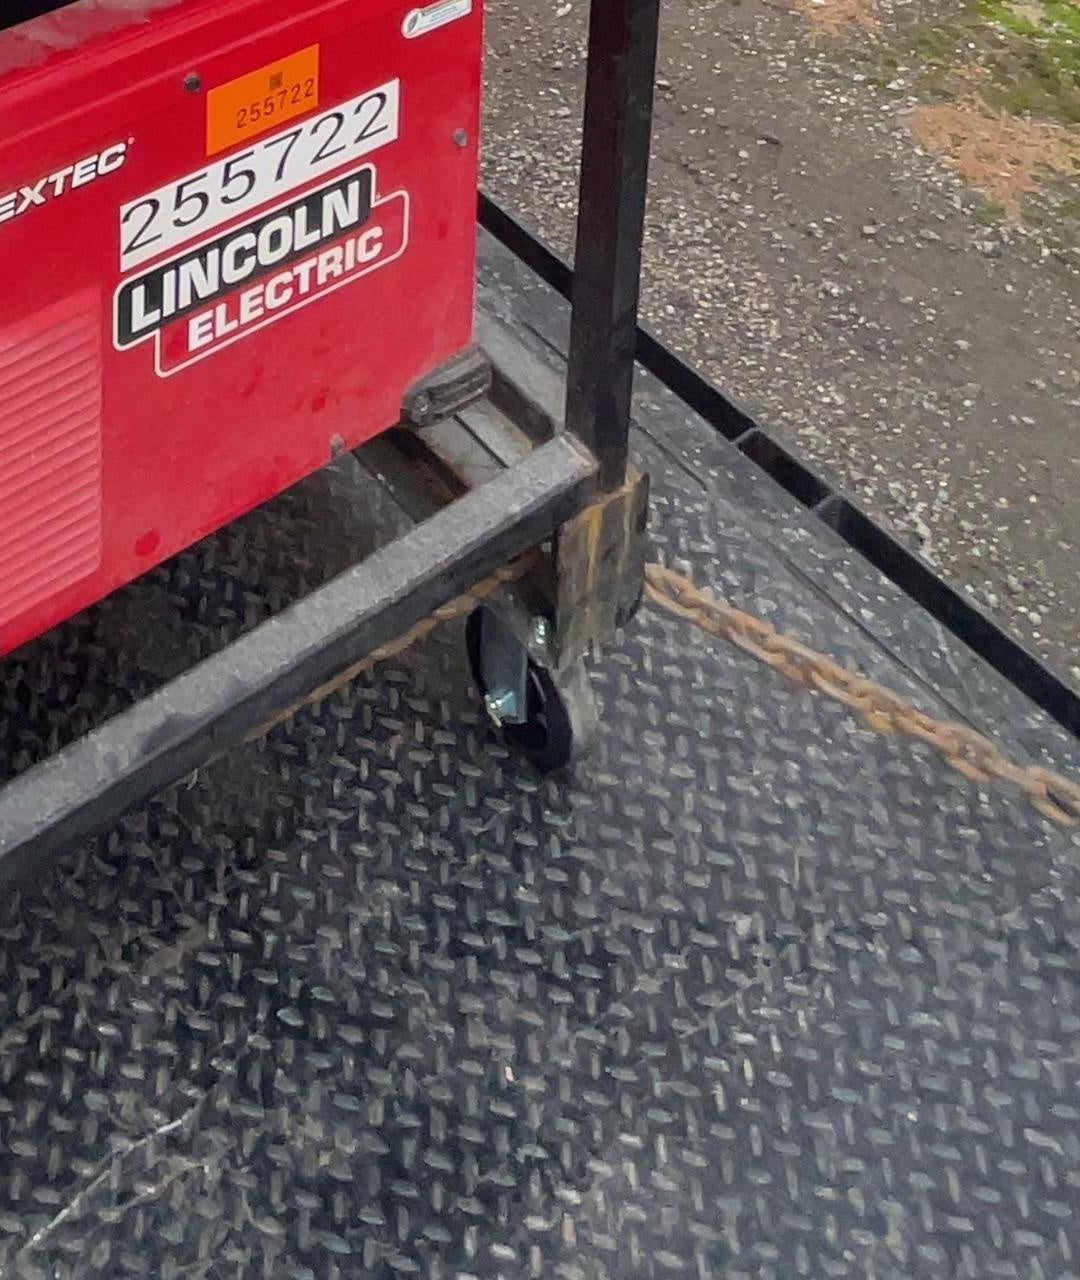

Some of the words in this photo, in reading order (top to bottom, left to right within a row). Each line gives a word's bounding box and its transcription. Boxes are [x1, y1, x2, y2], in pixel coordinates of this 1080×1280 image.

[121, 91, 390, 255] 255722
[236, 78, 315, 128] 255722
[130, 180, 361, 334] LINCOLN
[188, 225, 383, 353] ELECTRIC
